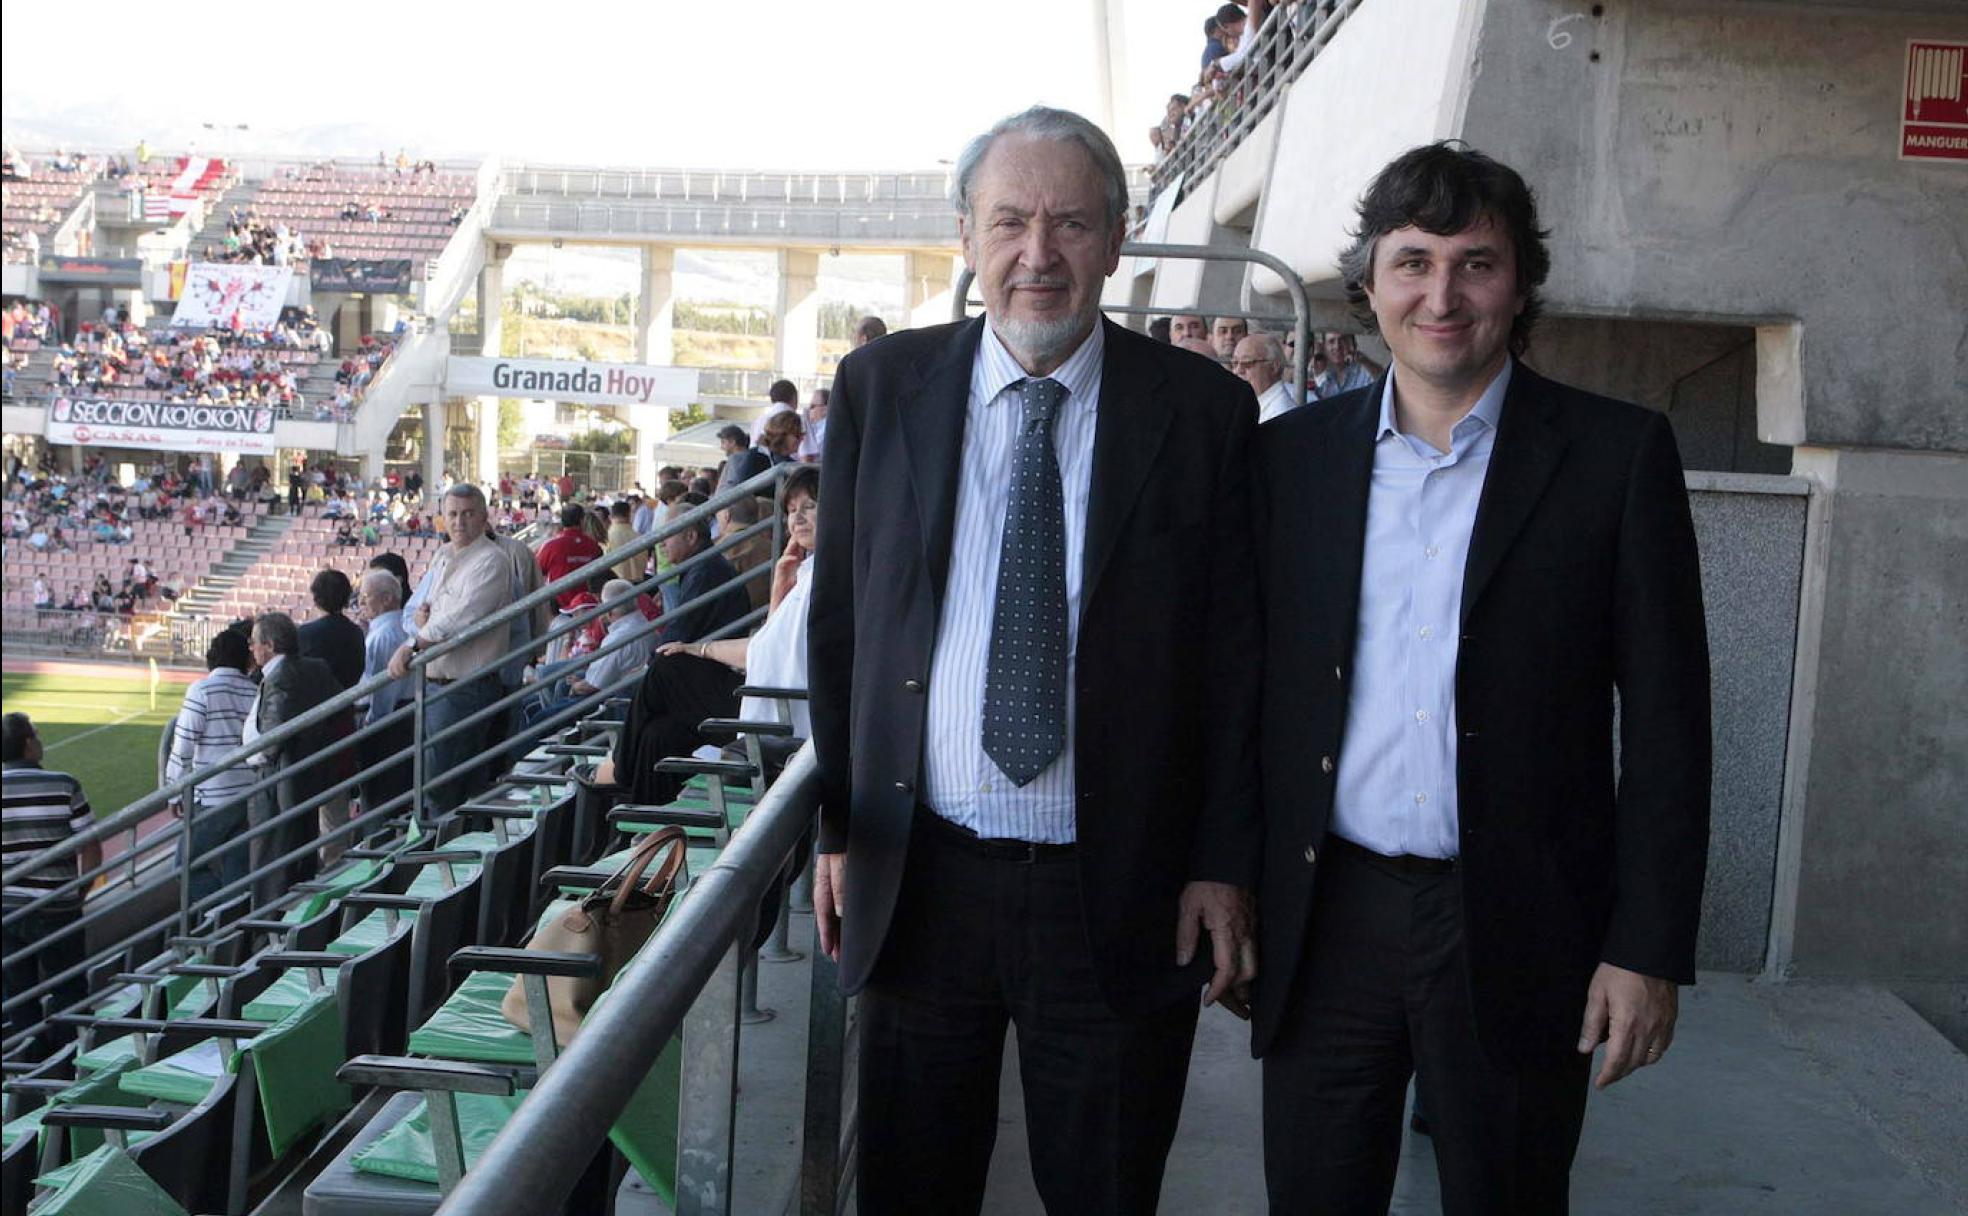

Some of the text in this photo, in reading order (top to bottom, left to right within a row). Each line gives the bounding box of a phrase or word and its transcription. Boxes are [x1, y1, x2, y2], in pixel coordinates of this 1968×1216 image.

[1547, 13, 1584, 50] 6
[493, 363, 656, 401] Granada Hoy
[161, 405, 254, 431] KOLOKON
